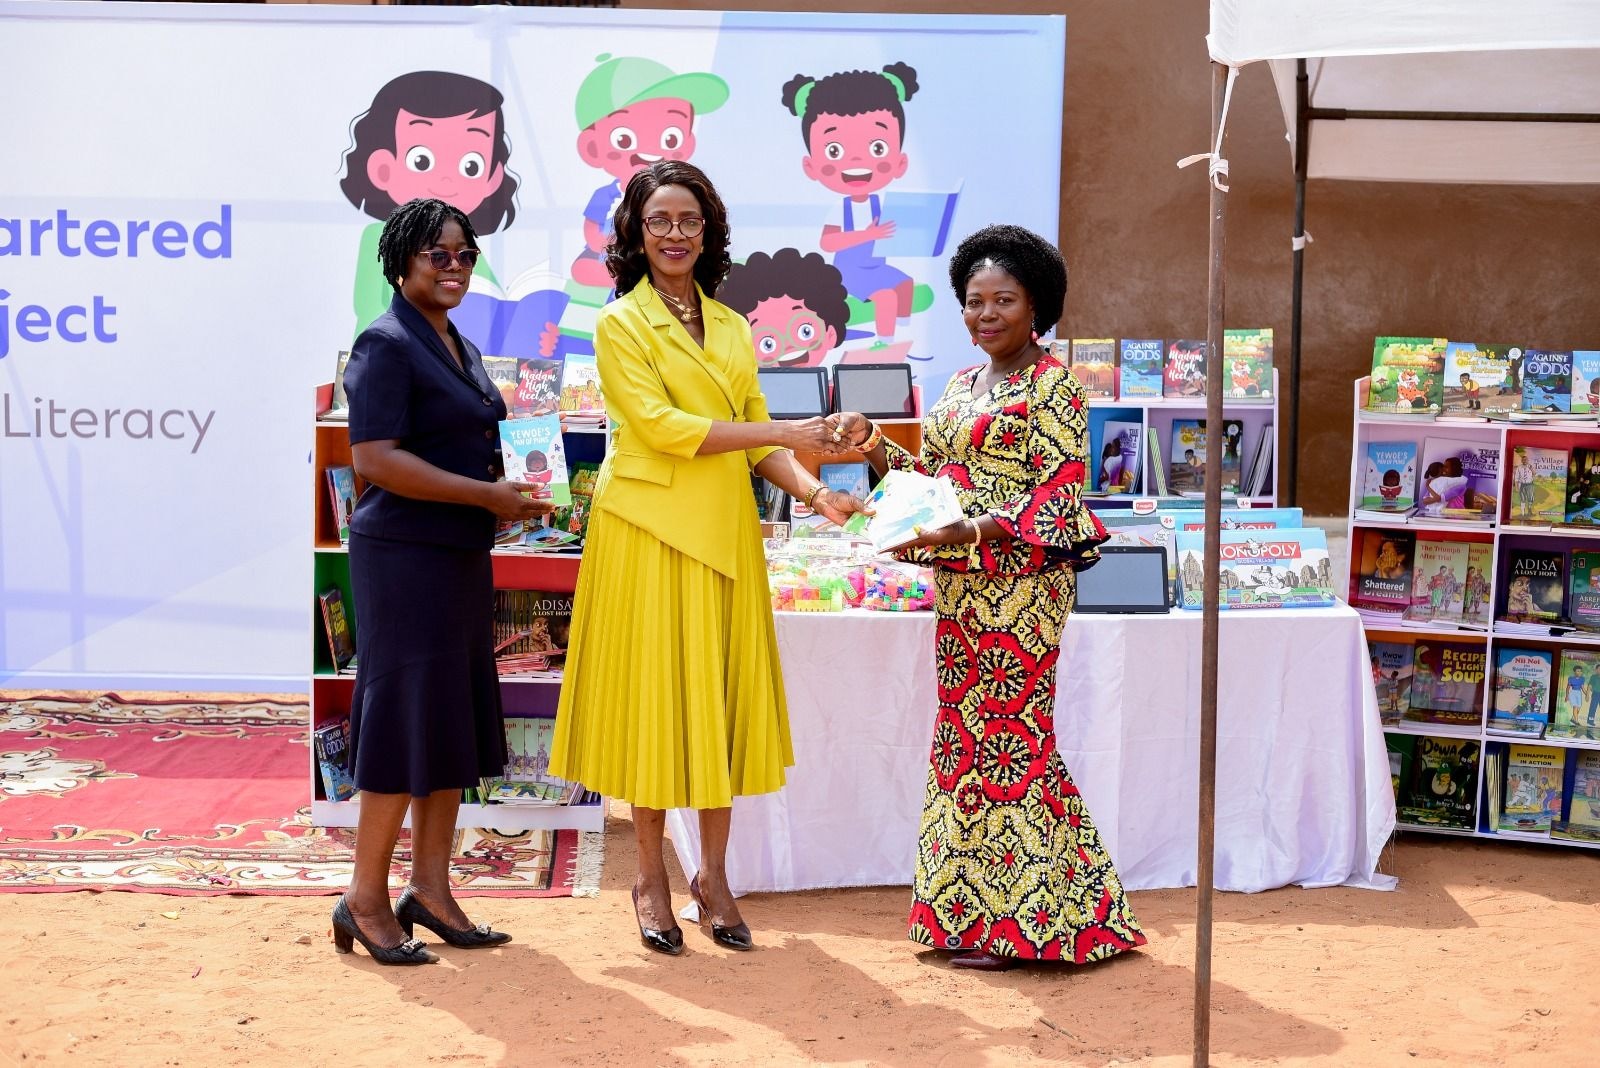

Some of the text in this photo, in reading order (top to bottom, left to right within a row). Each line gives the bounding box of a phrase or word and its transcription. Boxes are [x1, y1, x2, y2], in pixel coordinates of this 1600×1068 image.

[1127, 342, 1158, 350] AGAINST
[1075, 351, 1112, 362] HUNT
[1123, 349, 1160, 360] ODDS
[1168, 349, 1203, 361] Madam
[1531, 353, 1569, 362] AGAINST
[1174, 359, 1196, 372] High
[1527, 361, 1571, 376] ODDS
[1581, 359, 1600, 368] YEW
[519, 368, 557, 381] Madam
[525, 378, 549, 392] High
[4, 393, 215, 454] Literacy
[1534, 462, 1563, 471] Teacher
[1540, 457, 1563, 465] Village
[1220, 543, 1297, 558] ONOPOLY
[1435, 545, 1461, 554] Triumph
[1515, 558, 1558, 572] ADISA
[1365, 579, 1405, 592] Shattered
[532, 599, 572, 611] ADISA
[1442, 648, 1486, 662] RECIPE
[1455, 661, 1485, 671] LIGHT
[1440, 667, 1485, 684] SOUP
[1516, 752, 1556, 760] KIDNAPPERS
